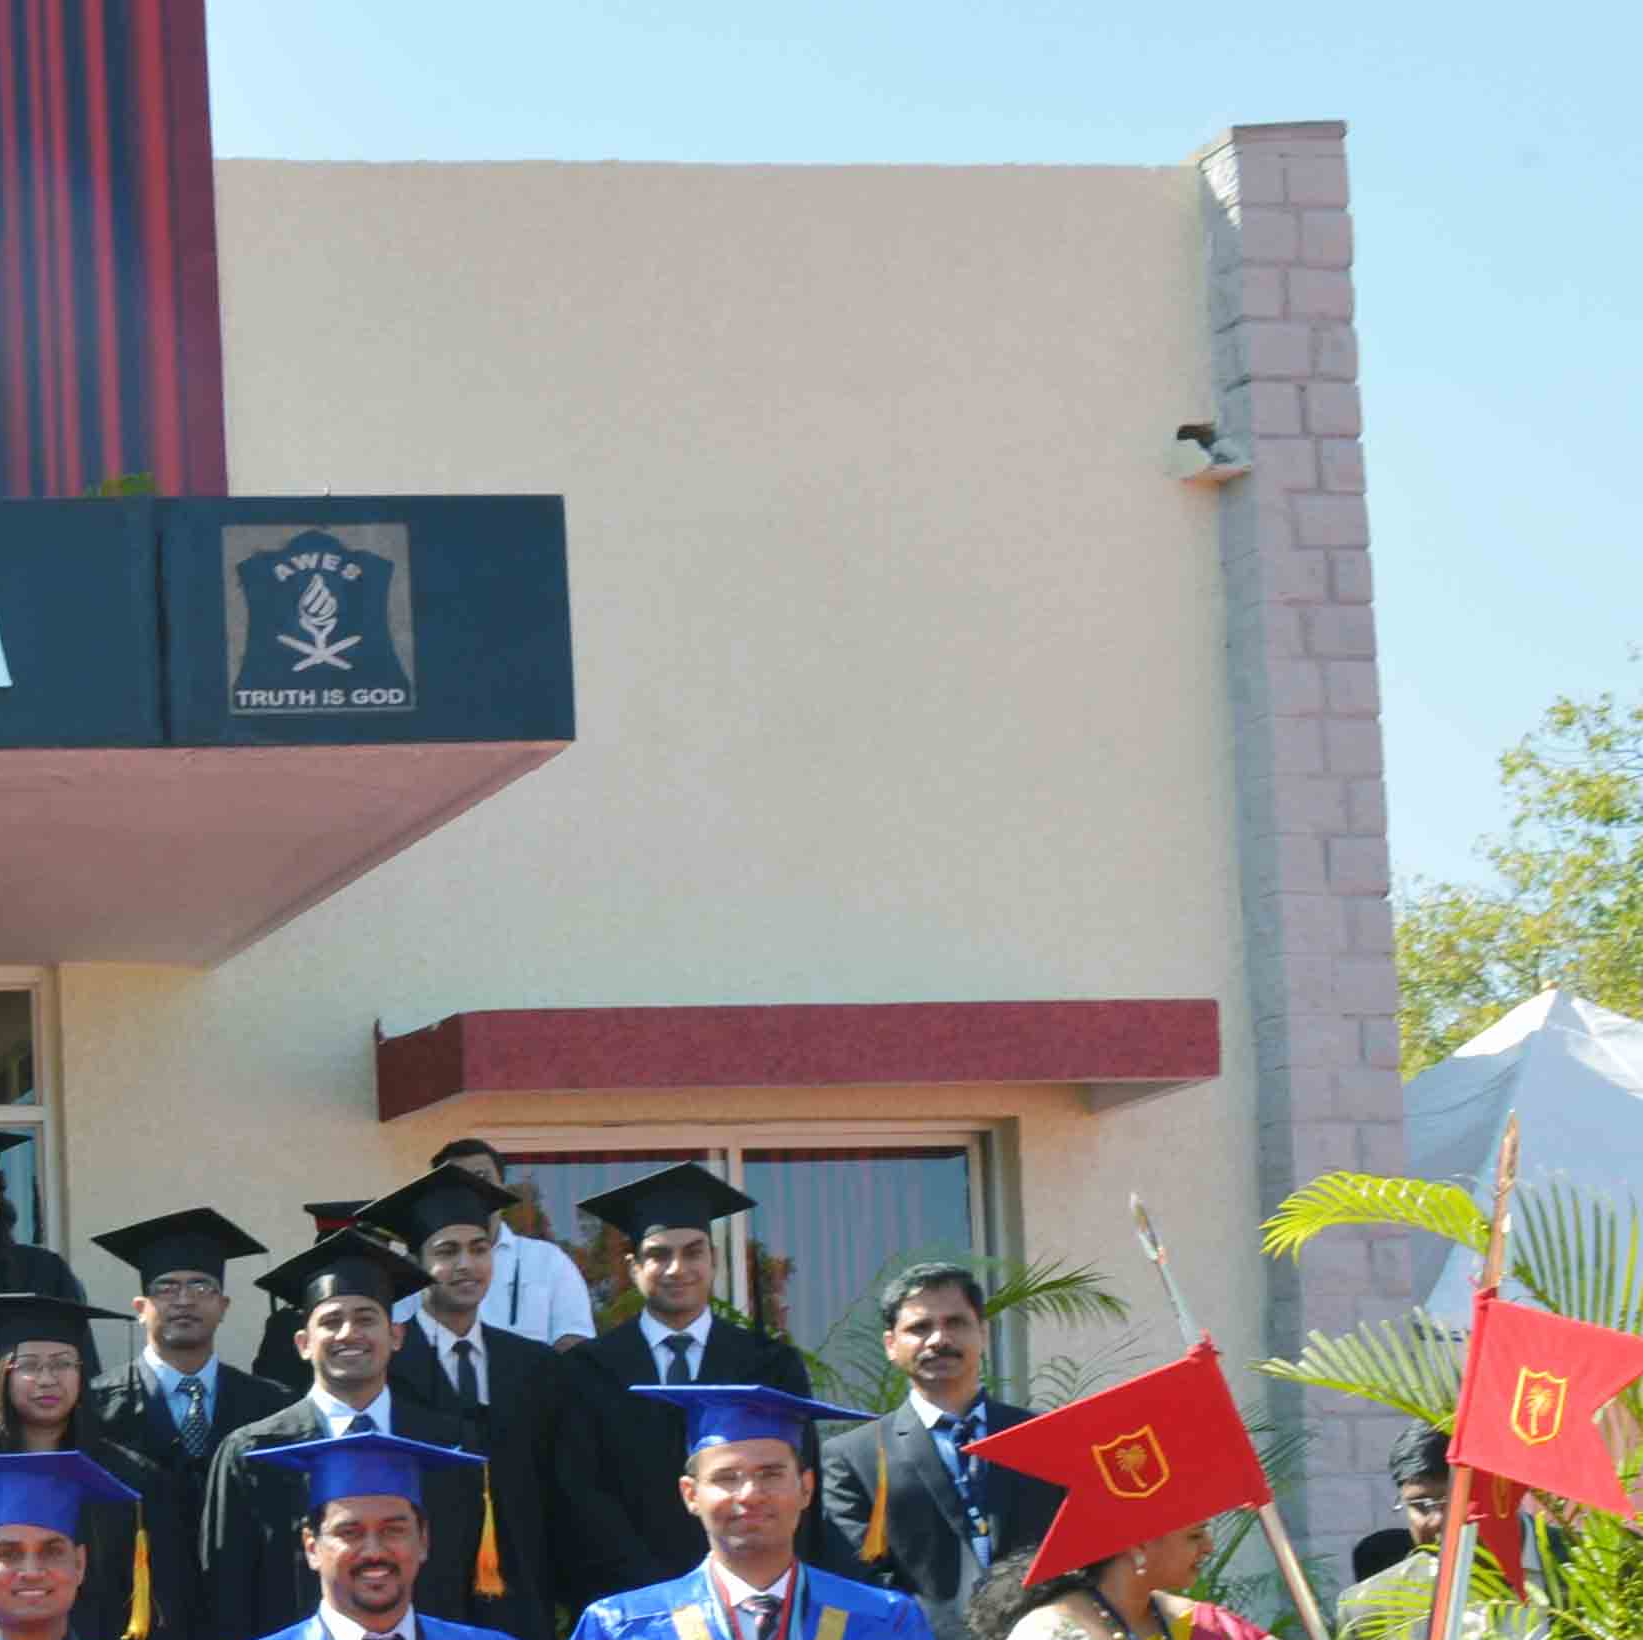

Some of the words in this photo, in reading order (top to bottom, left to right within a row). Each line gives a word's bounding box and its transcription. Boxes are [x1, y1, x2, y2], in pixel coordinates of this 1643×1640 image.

[273, 552, 363, 581] AWES
[235, 688, 315, 707] TRUTH
[321, 688, 345, 705] IS
[350, 687, 405, 705] GOD
